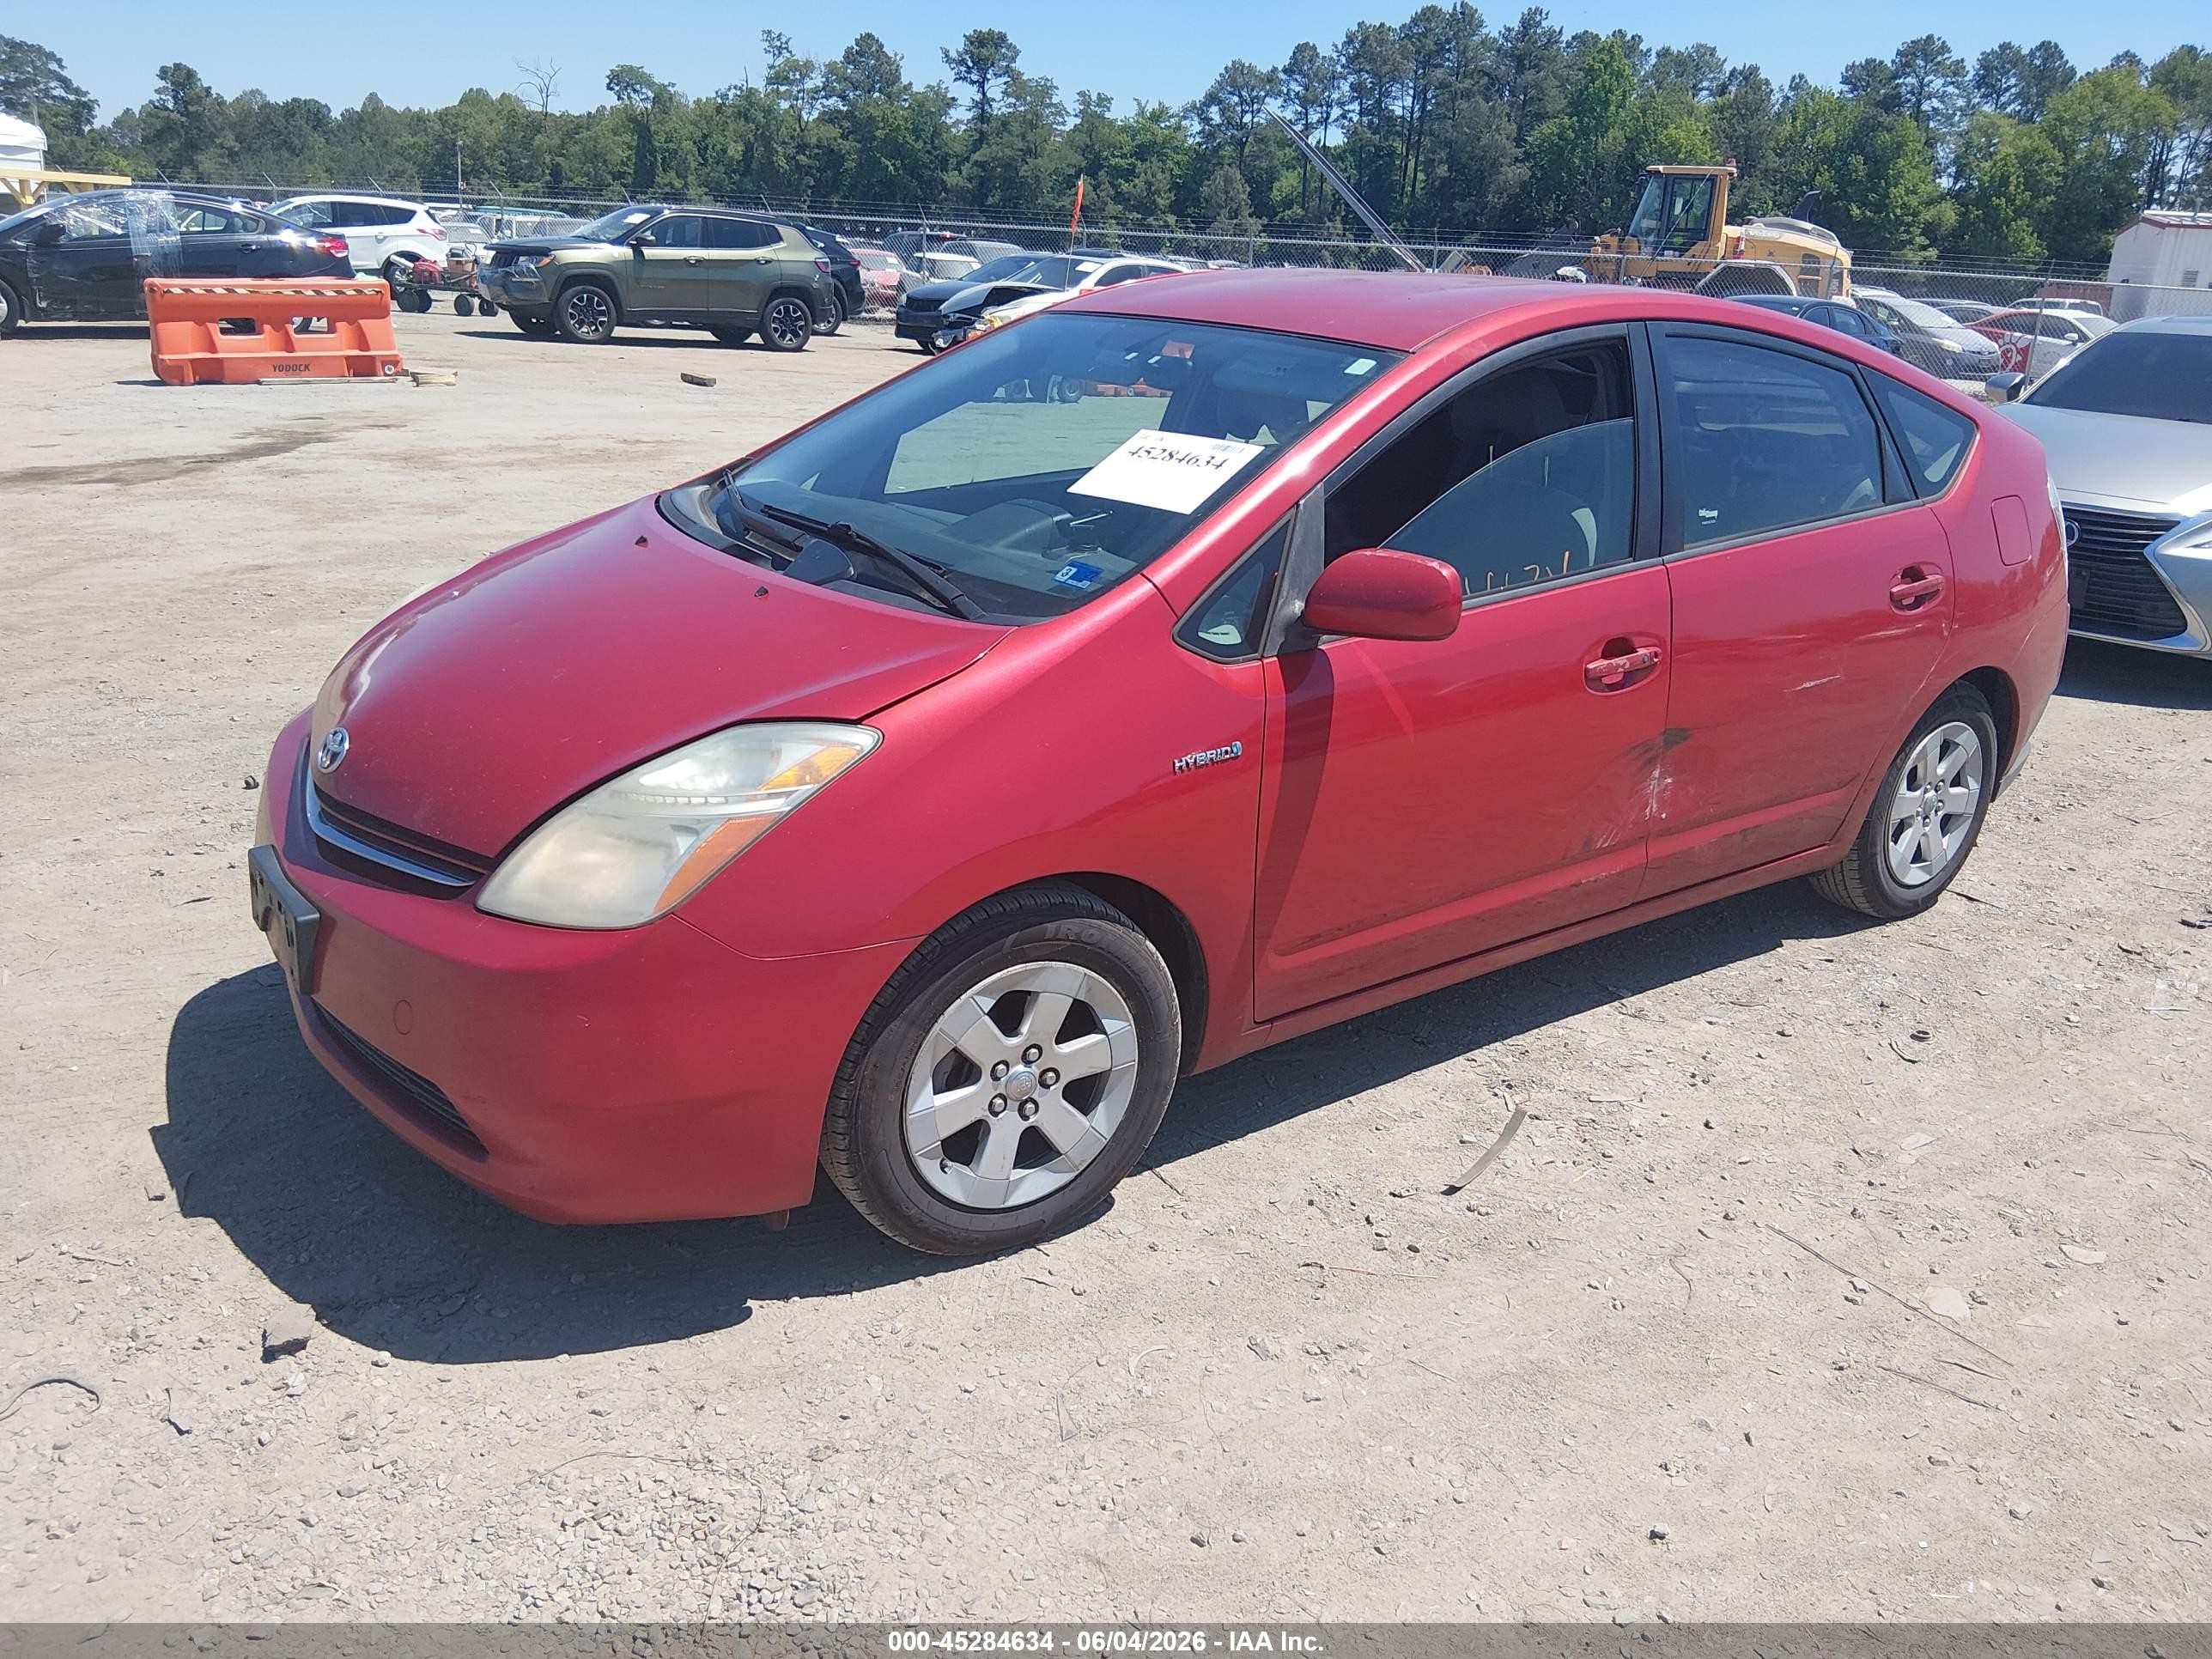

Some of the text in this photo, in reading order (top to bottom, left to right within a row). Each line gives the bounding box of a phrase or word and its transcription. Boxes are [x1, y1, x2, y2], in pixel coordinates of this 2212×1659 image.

[272, 363, 311, 372] YODOCK
[1127, 441, 1230, 470] 45284634
[1173, 746, 1233, 771] HYBRID
